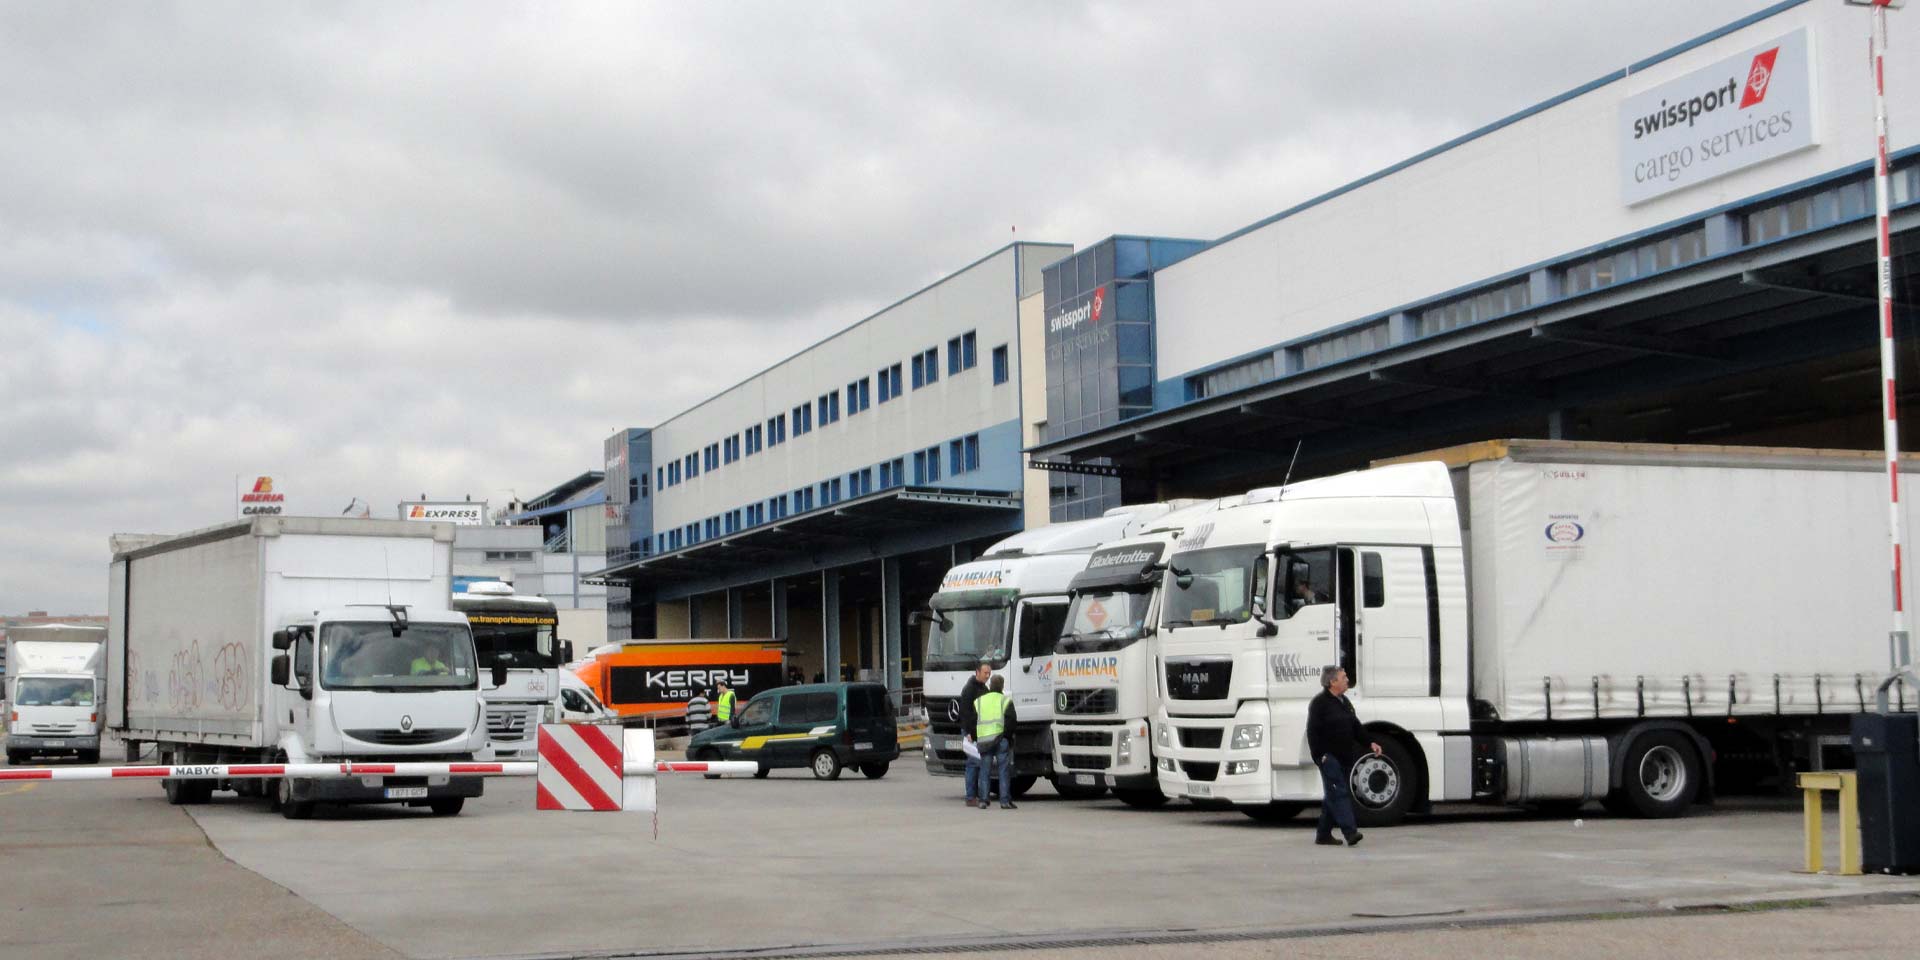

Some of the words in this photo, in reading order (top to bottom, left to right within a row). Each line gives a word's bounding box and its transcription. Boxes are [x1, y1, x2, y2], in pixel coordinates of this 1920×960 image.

[1634, 77, 1737, 139] swissport
[1634, 146, 1694, 182] cargo
[1700, 110, 1793, 161] services
[1050, 300, 1091, 333] swissport
[241, 493, 285, 503] IBERIA
[242, 505, 282, 515] CARGO
[425, 510, 478, 518] EXPRESS
[1089, 550, 1155, 569] Globetrotter
[944, 570, 1001, 587] VALMENAR
[1057, 656, 1119, 678] VALMENAR
[646, 669, 749, 688] KERRY
[1182, 672, 1209, 683] MAN
[175, 766, 220, 776] MABYC
